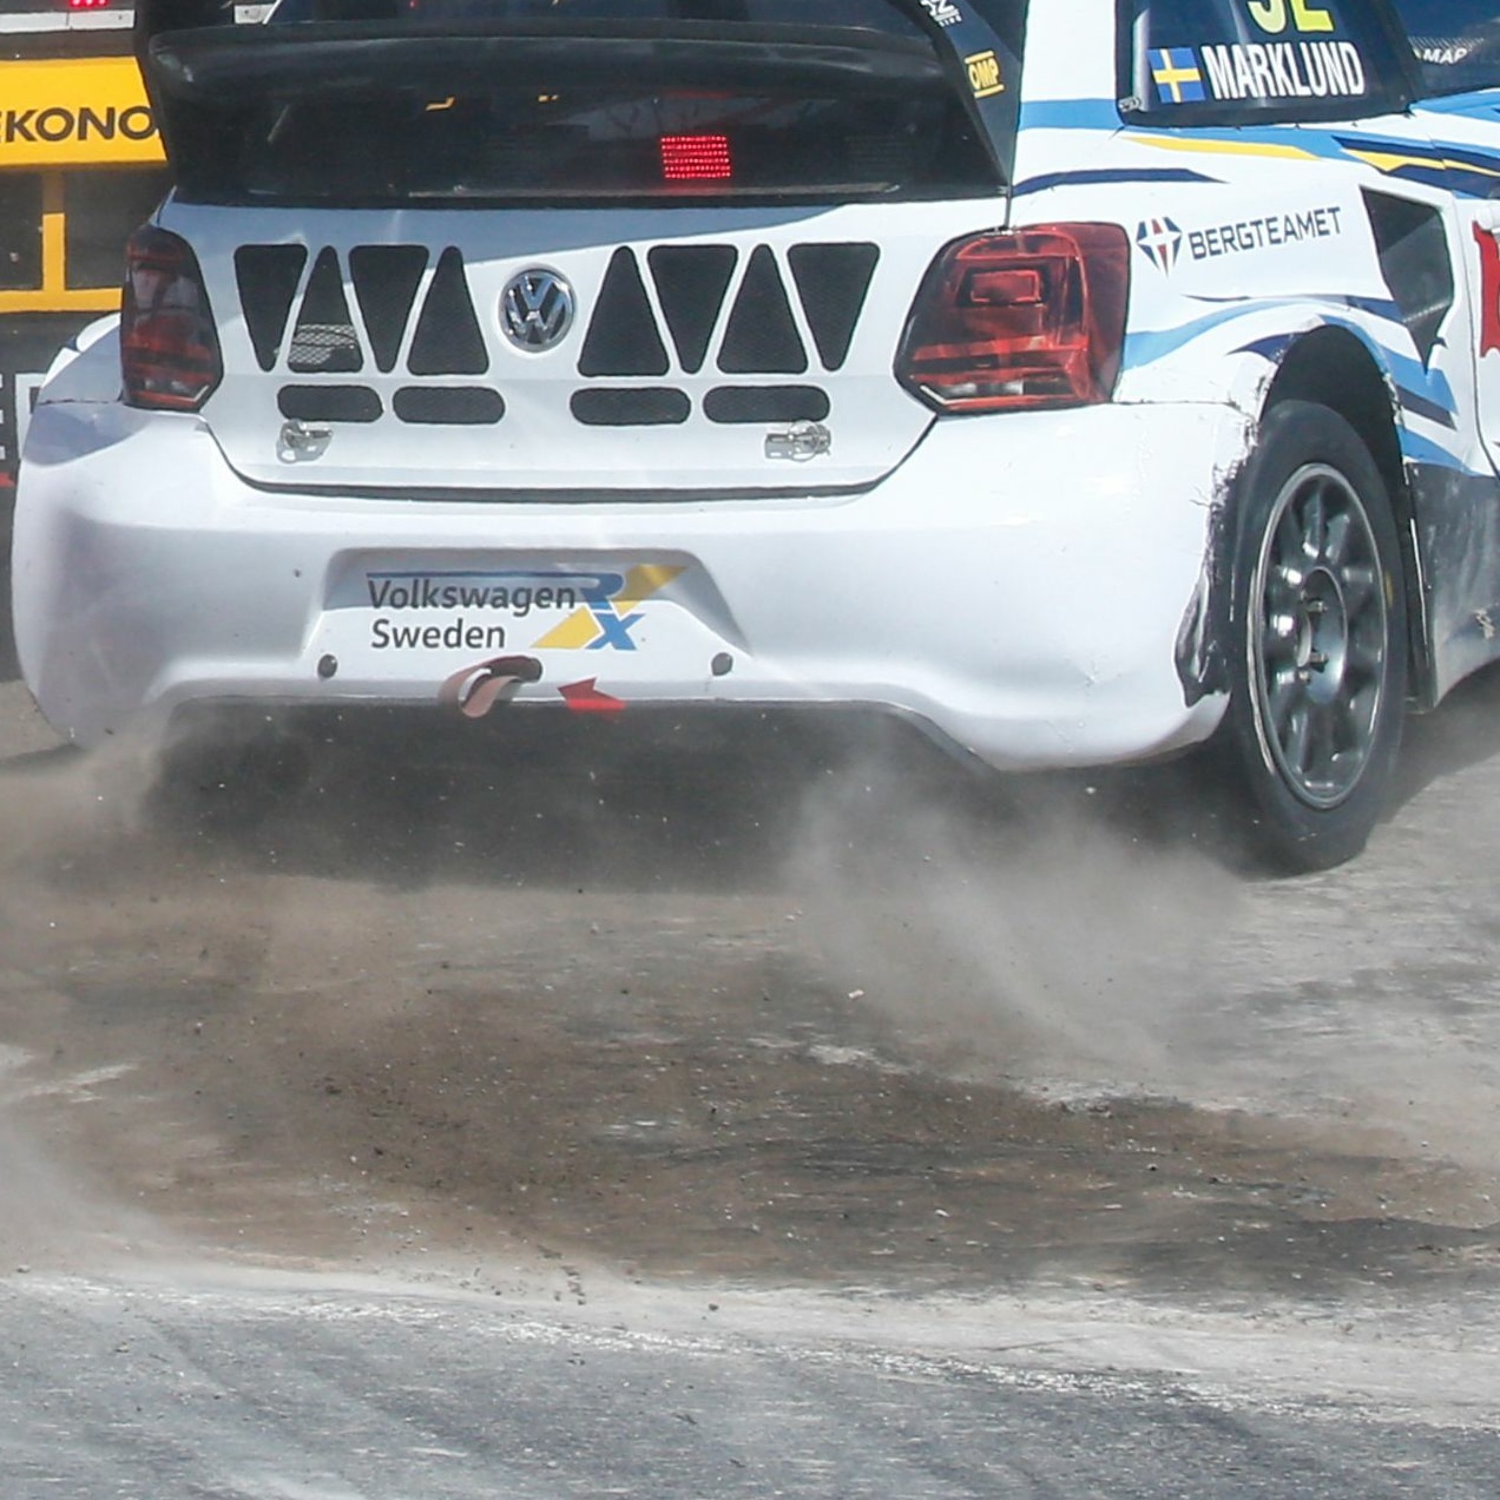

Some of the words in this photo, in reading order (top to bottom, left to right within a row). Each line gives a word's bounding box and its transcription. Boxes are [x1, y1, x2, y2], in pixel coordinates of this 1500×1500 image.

[968, 57, 1000, 90] OMP
[1201, 42, 1366, 100] MARKLUND
[1187, 206, 1341, 261] BERGTEAMET
[367, 579, 576, 617] Volkswagen
[371, 618, 506, 649] Sweden
